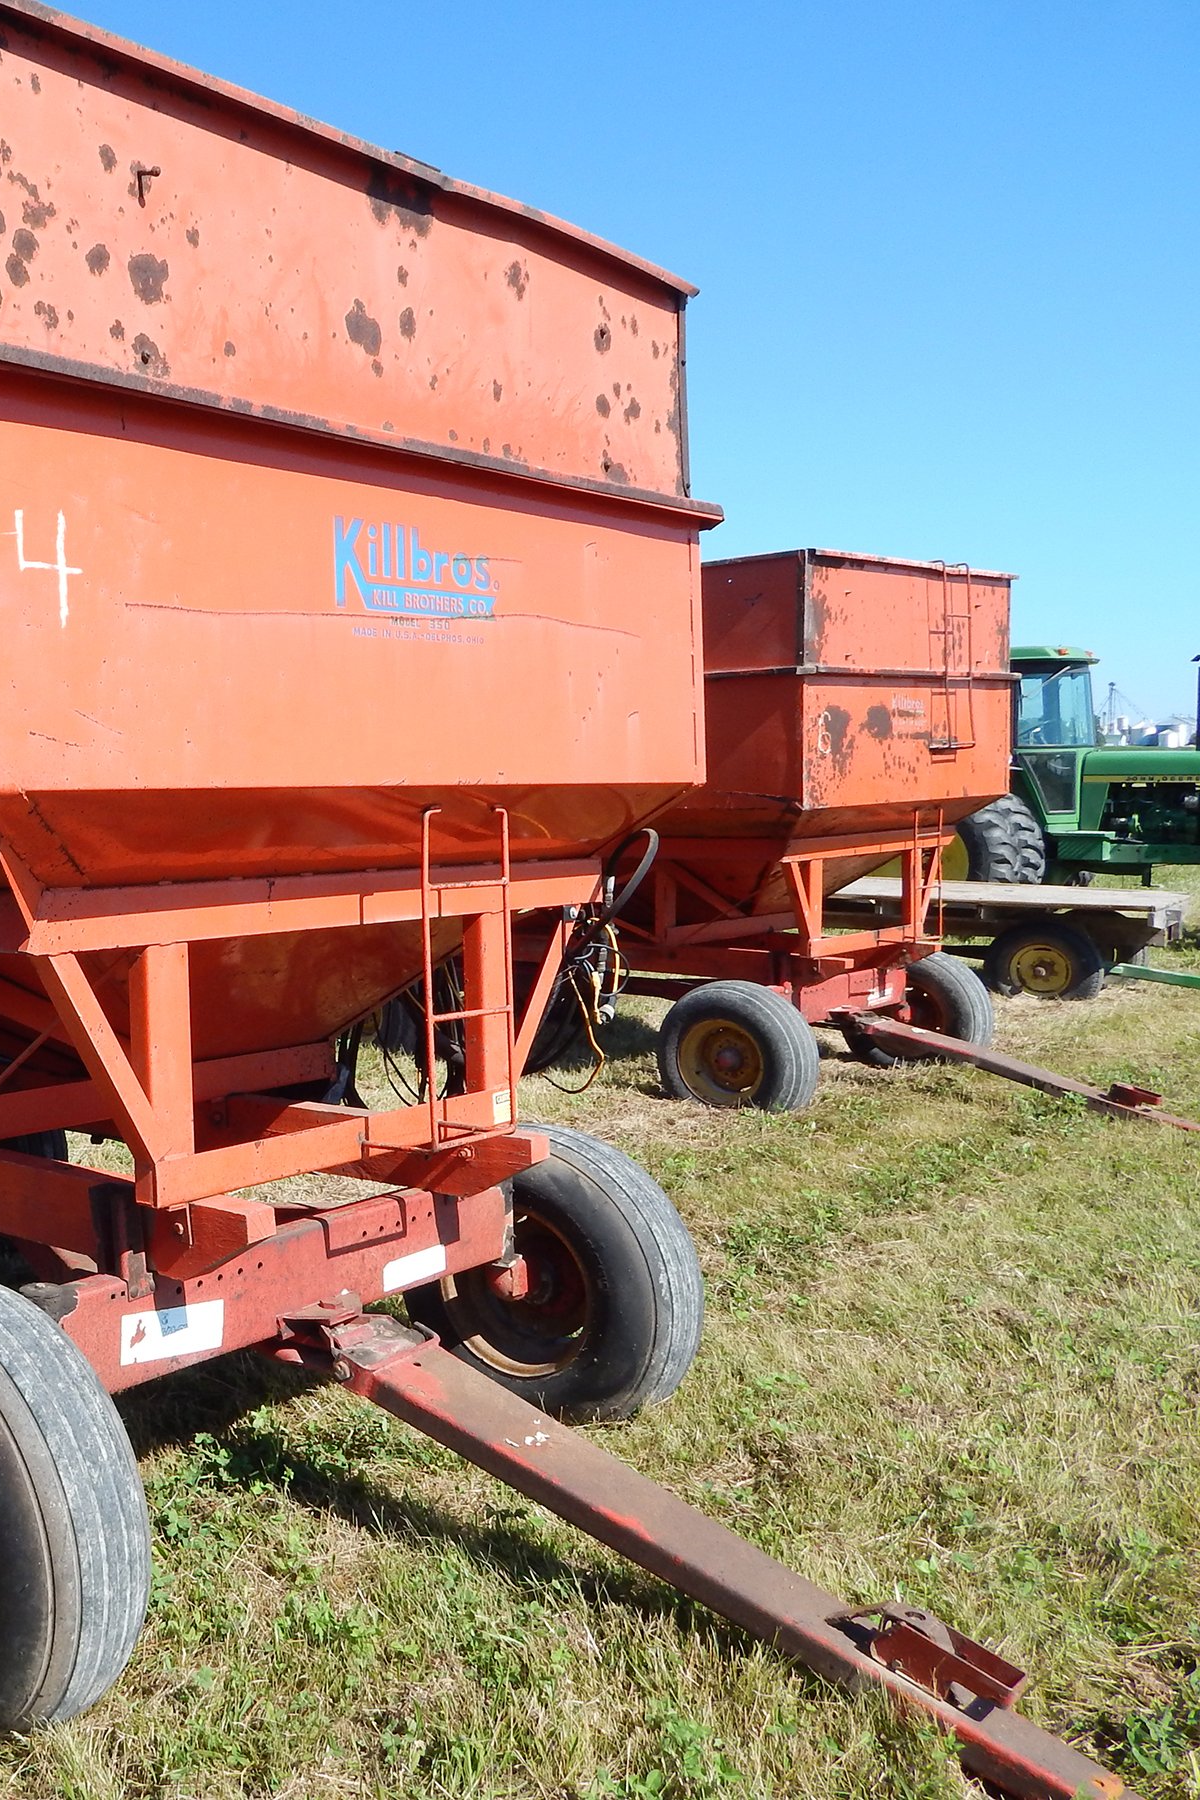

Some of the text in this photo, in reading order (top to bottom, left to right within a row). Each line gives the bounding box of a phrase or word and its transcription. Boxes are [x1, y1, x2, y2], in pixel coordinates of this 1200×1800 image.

[14, 509, 84, 629] 4
[333, 515, 491, 608] Killbros
[372, 588, 490, 615] KILL BROTHERS CO.
[352, 627, 377, 637] MADE
[382, 630, 391, 638] IN
[390, 617, 420, 628] MODEL
